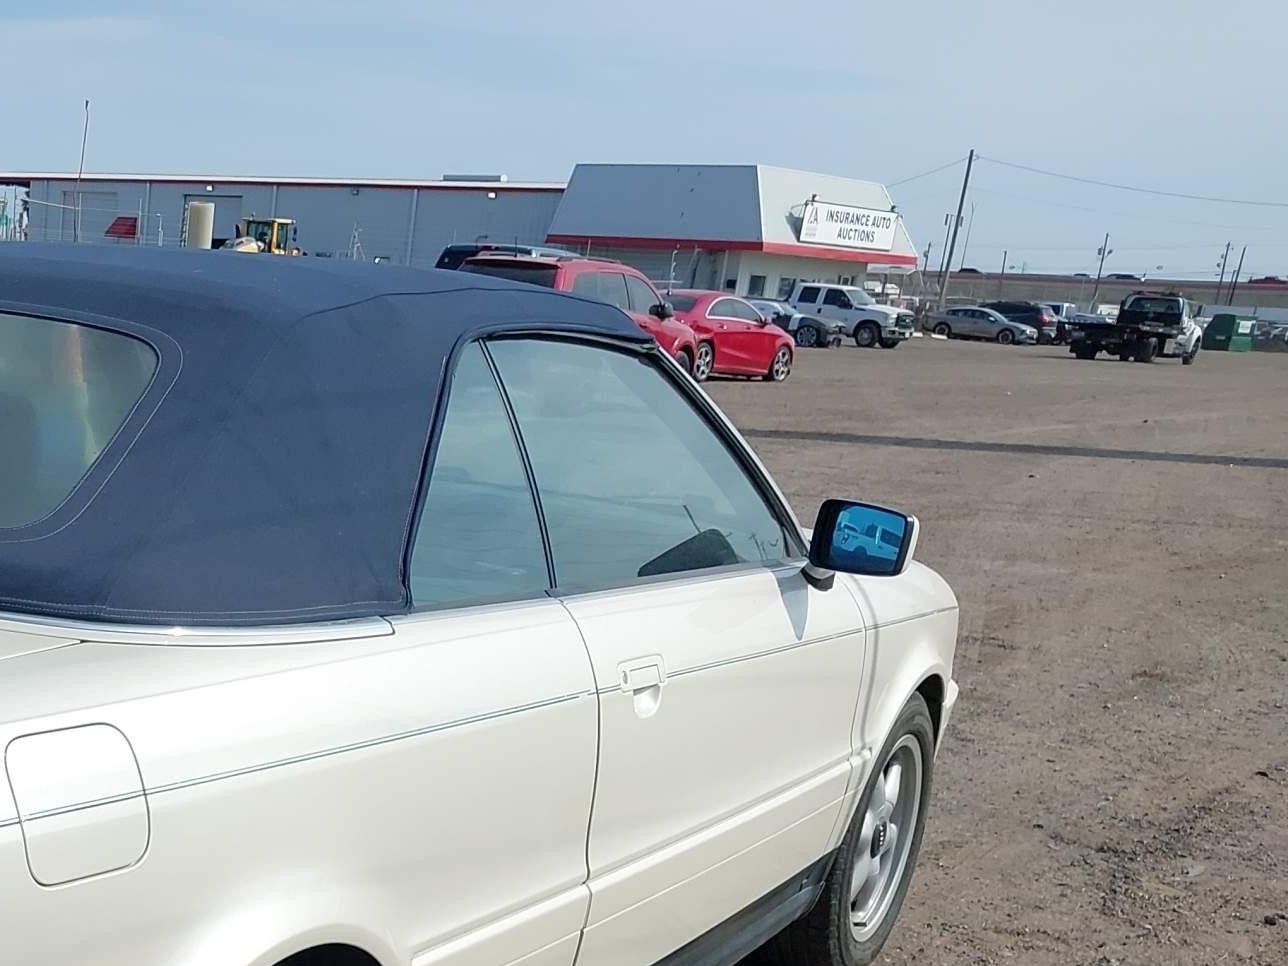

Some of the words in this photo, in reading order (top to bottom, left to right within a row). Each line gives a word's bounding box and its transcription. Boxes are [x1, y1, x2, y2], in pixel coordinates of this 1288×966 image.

[825, 208, 870, 227] INSURANCE
[870, 215, 891, 230] AUTO
[837, 227, 875, 243] AUCTIONS
